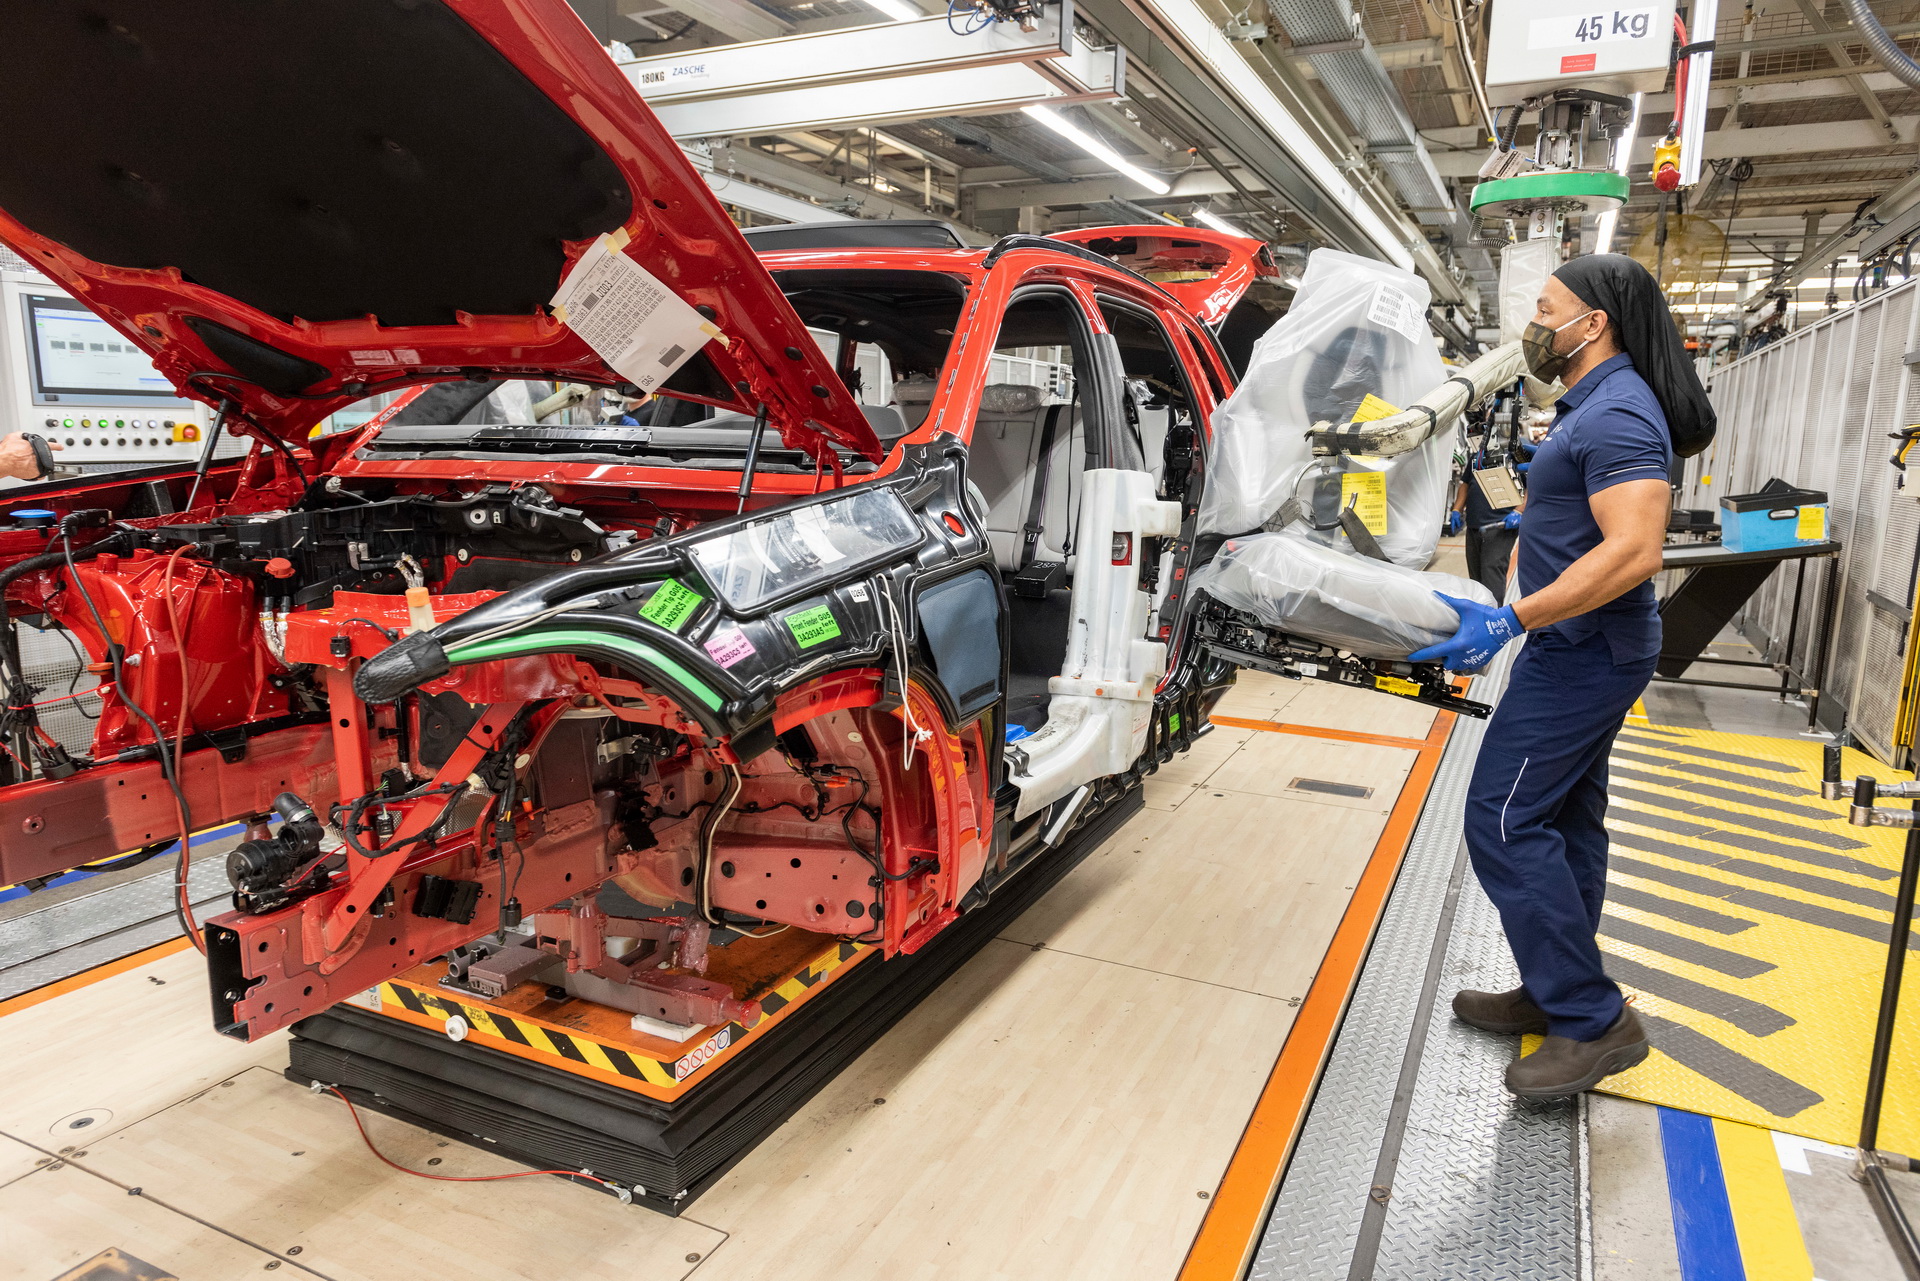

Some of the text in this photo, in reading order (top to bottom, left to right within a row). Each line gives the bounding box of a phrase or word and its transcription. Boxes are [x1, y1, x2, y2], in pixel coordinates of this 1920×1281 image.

[1575, 11, 1649, 42] 45 kg
[642, 71, 664, 83] 180KG
[672, 64, 706, 76] ZASCHE
[626, 270, 635, 280] 302
[626, 281, 636, 292] 44A
[632, 275, 641, 284] 453
[641, 375, 655, 387] GAS
[650, 602, 667, 620] Fender
[668, 583, 681, 597] G05
[677, 589, 688, 601] left
[662, 601, 686, 627] 3A293C5
[791, 621, 803, 631] Front
[803, 616, 818, 627] Fender
[818, 611, 830, 620] G05
[821, 619, 834, 627] left
[797, 626, 824, 642] 3A293A5
[1462, 650, 1489, 665] HyFlex
